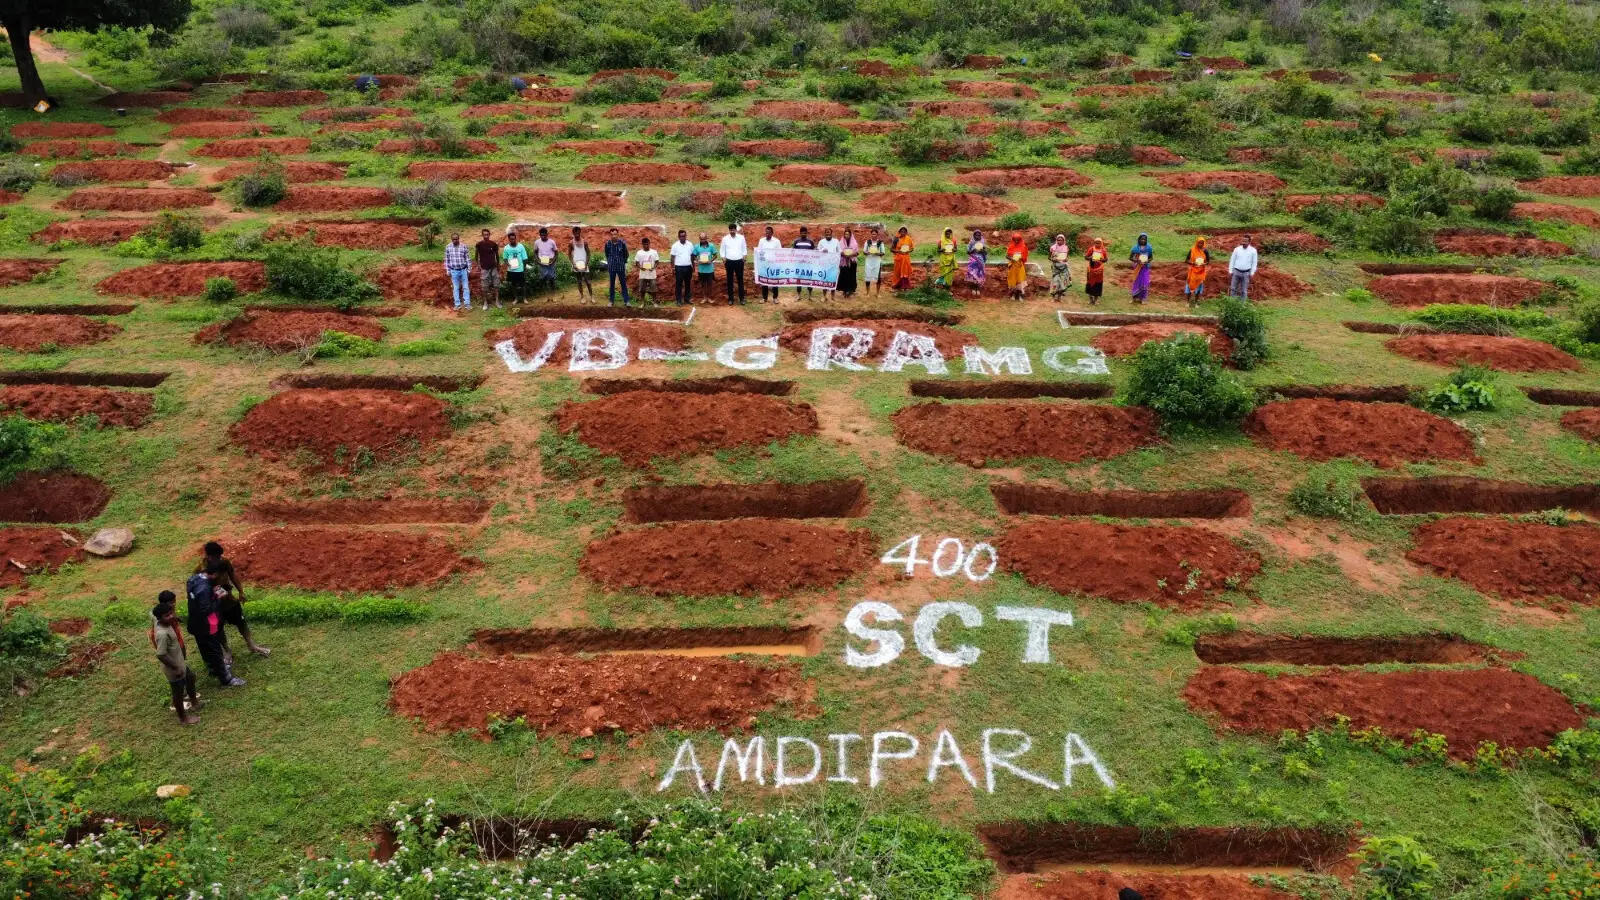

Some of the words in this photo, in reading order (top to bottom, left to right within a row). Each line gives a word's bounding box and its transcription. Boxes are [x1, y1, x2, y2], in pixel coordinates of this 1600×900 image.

[881, 534, 998, 582] 400
[844, 601, 1074, 668] SCT
[658, 728, 1116, 794] AMDIPARA
